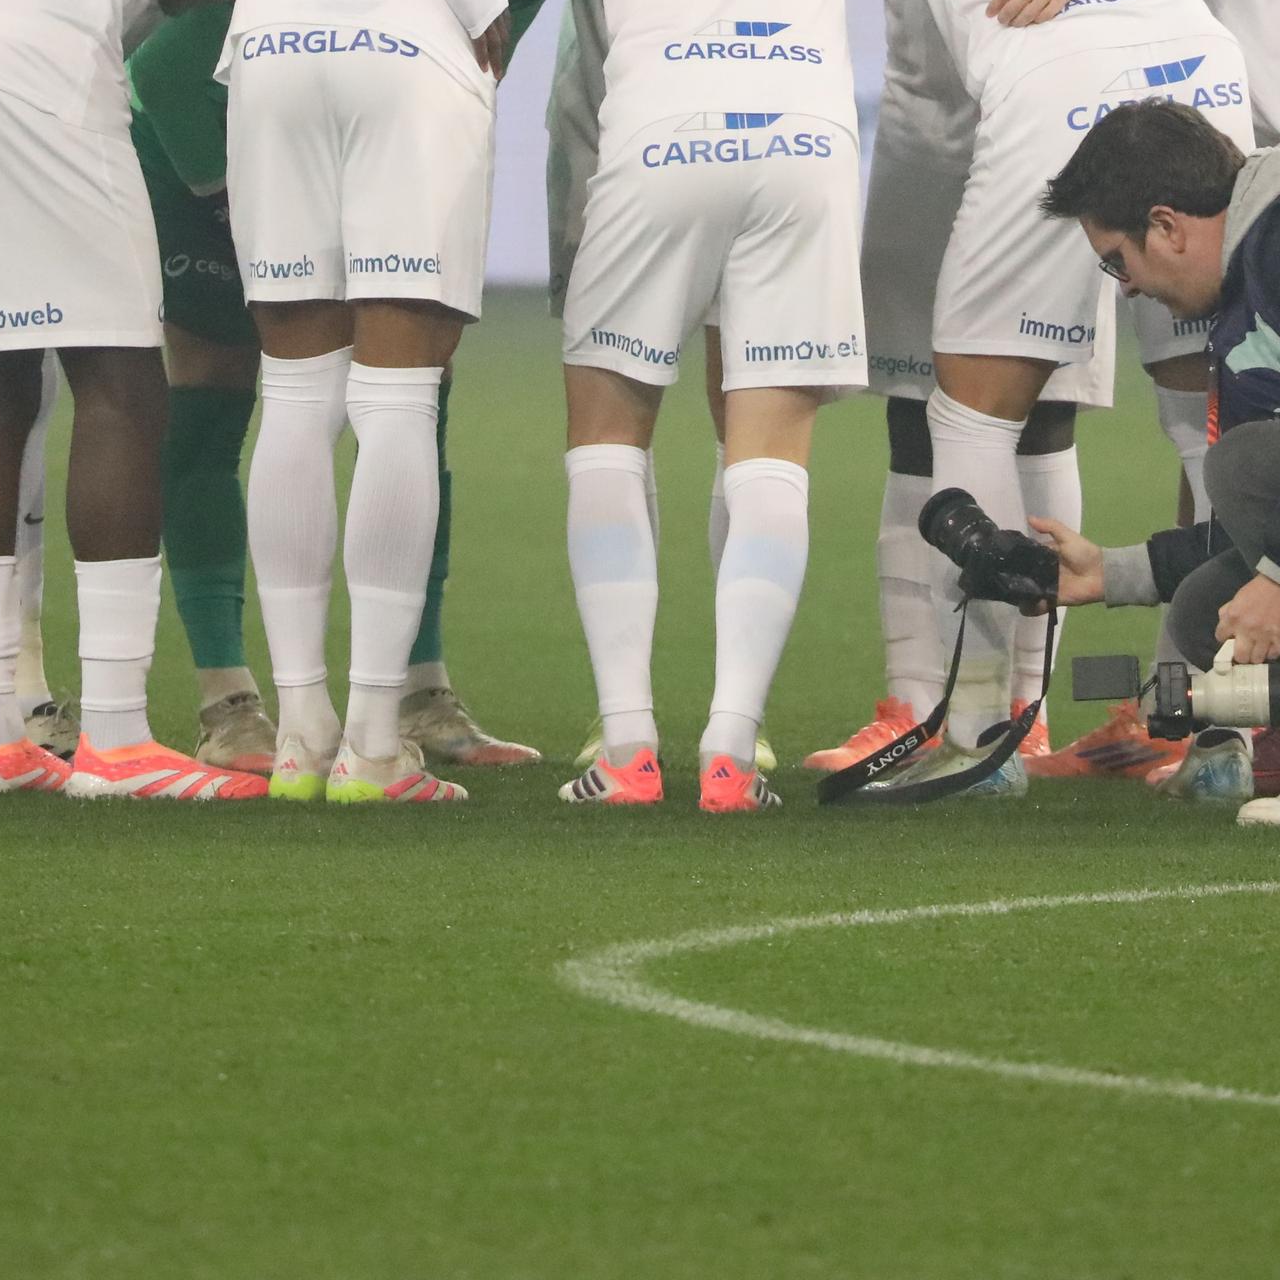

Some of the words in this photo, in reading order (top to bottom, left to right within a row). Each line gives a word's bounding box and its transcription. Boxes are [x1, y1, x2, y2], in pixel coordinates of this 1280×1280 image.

[664, 41, 823, 65] CARGLASS
[643, 133, 832, 168] CARGLASS
[866, 735, 918, 777] SONY
